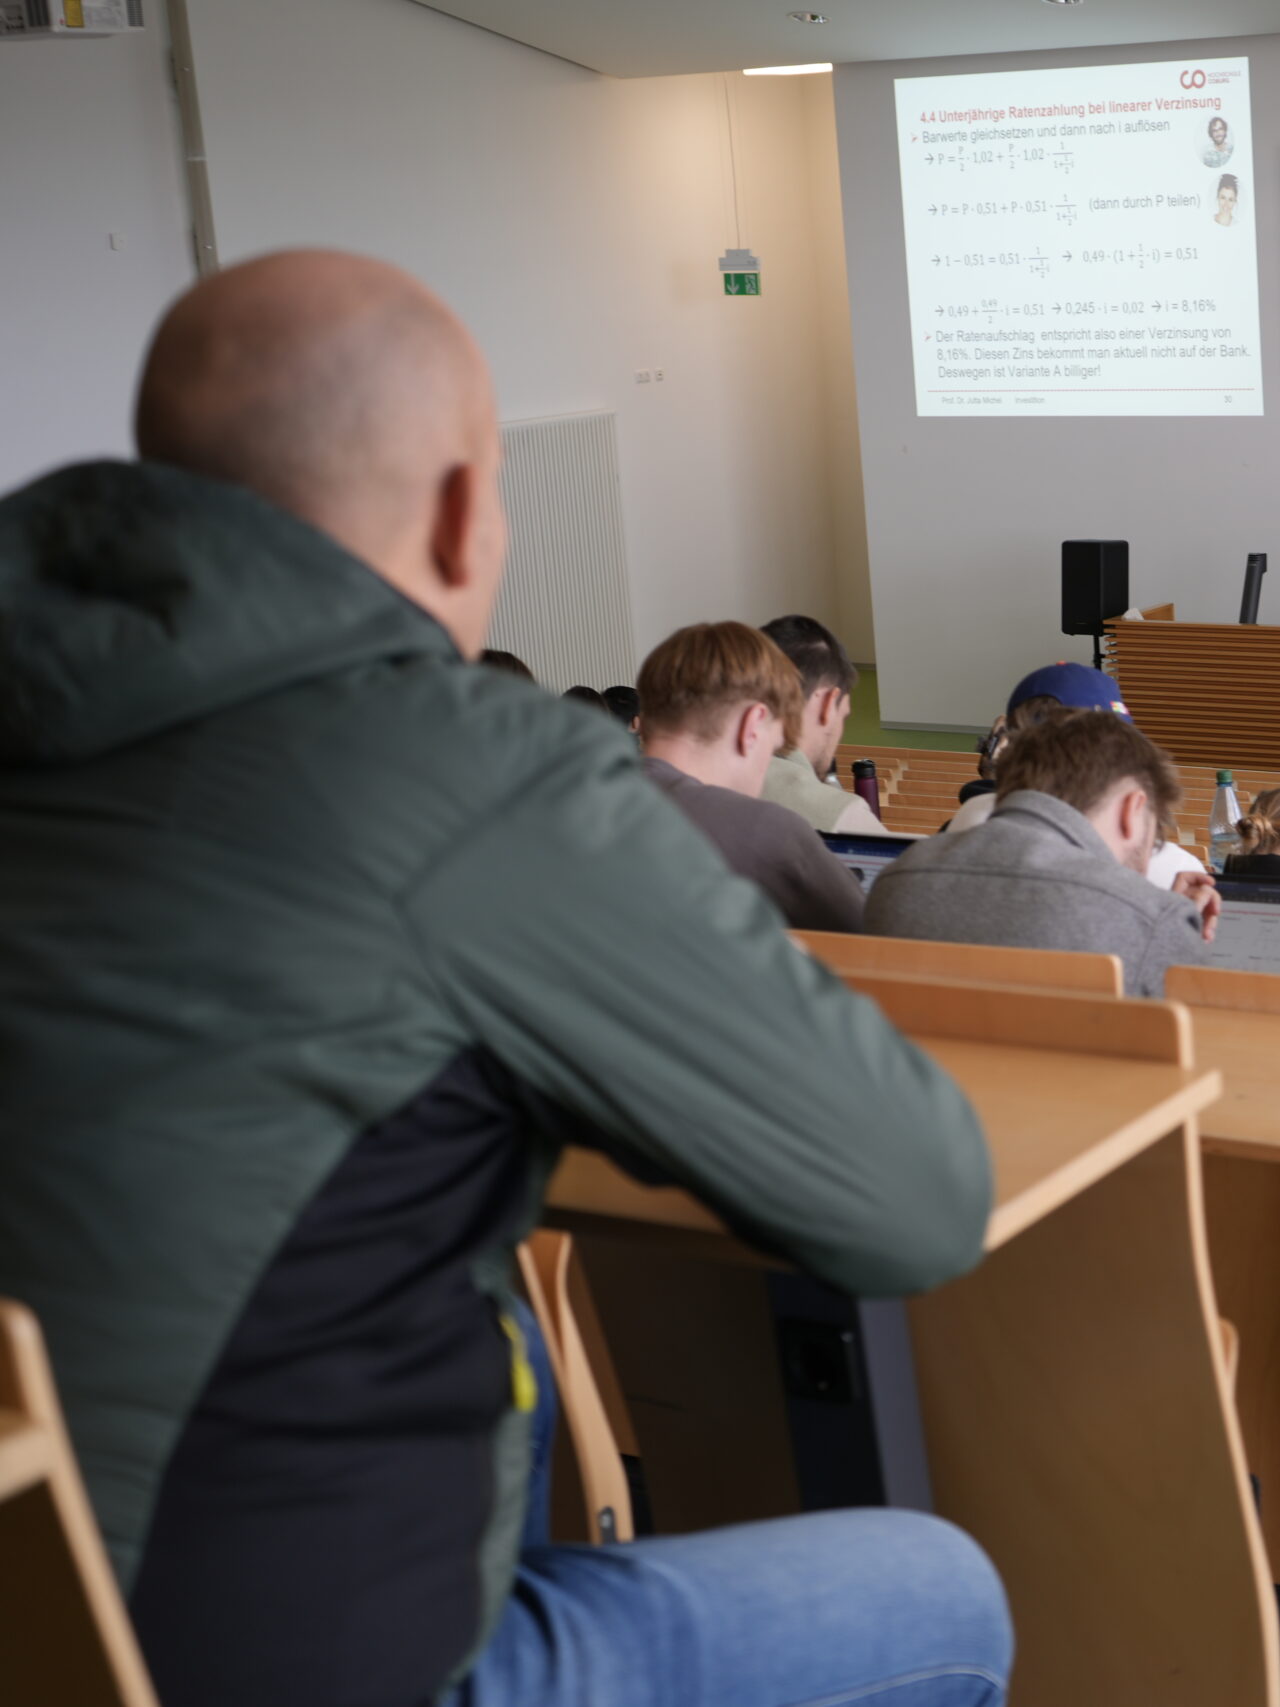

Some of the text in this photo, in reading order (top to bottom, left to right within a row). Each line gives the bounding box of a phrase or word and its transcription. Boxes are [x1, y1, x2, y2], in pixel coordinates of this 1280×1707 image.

[920, 97, 1221, 124] 4.4 Unterjährige Ratenzahlung bei linearer Verzinsung
[923, 131, 967, 143] Barwerte
[971, 127, 1033, 143] gleichsetzen
[1037, 125, 1056, 137] und
[1060, 124, 1086, 136] dann
[1090, 122, 1115, 134] nach
[1125, 120, 1170, 133] auflösen
[1123, 196, 1152, 209] durch
[1156, 195, 1164, 206] P
[936, 328, 1231, 343] Der Ratenaufschlag entspricht also einer Verzinsung von
[975, 348, 1009, 359] Diesen
[1013, 347, 1034, 359] Zins
[1038, 346, 1085, 359] bekommt
[938, 366, 991, 380] Deswegen
[994, 366, 1005, 377] ist
[1009, 365, 1050, 377] Variante
[1053, 365, 1061, 376] A
